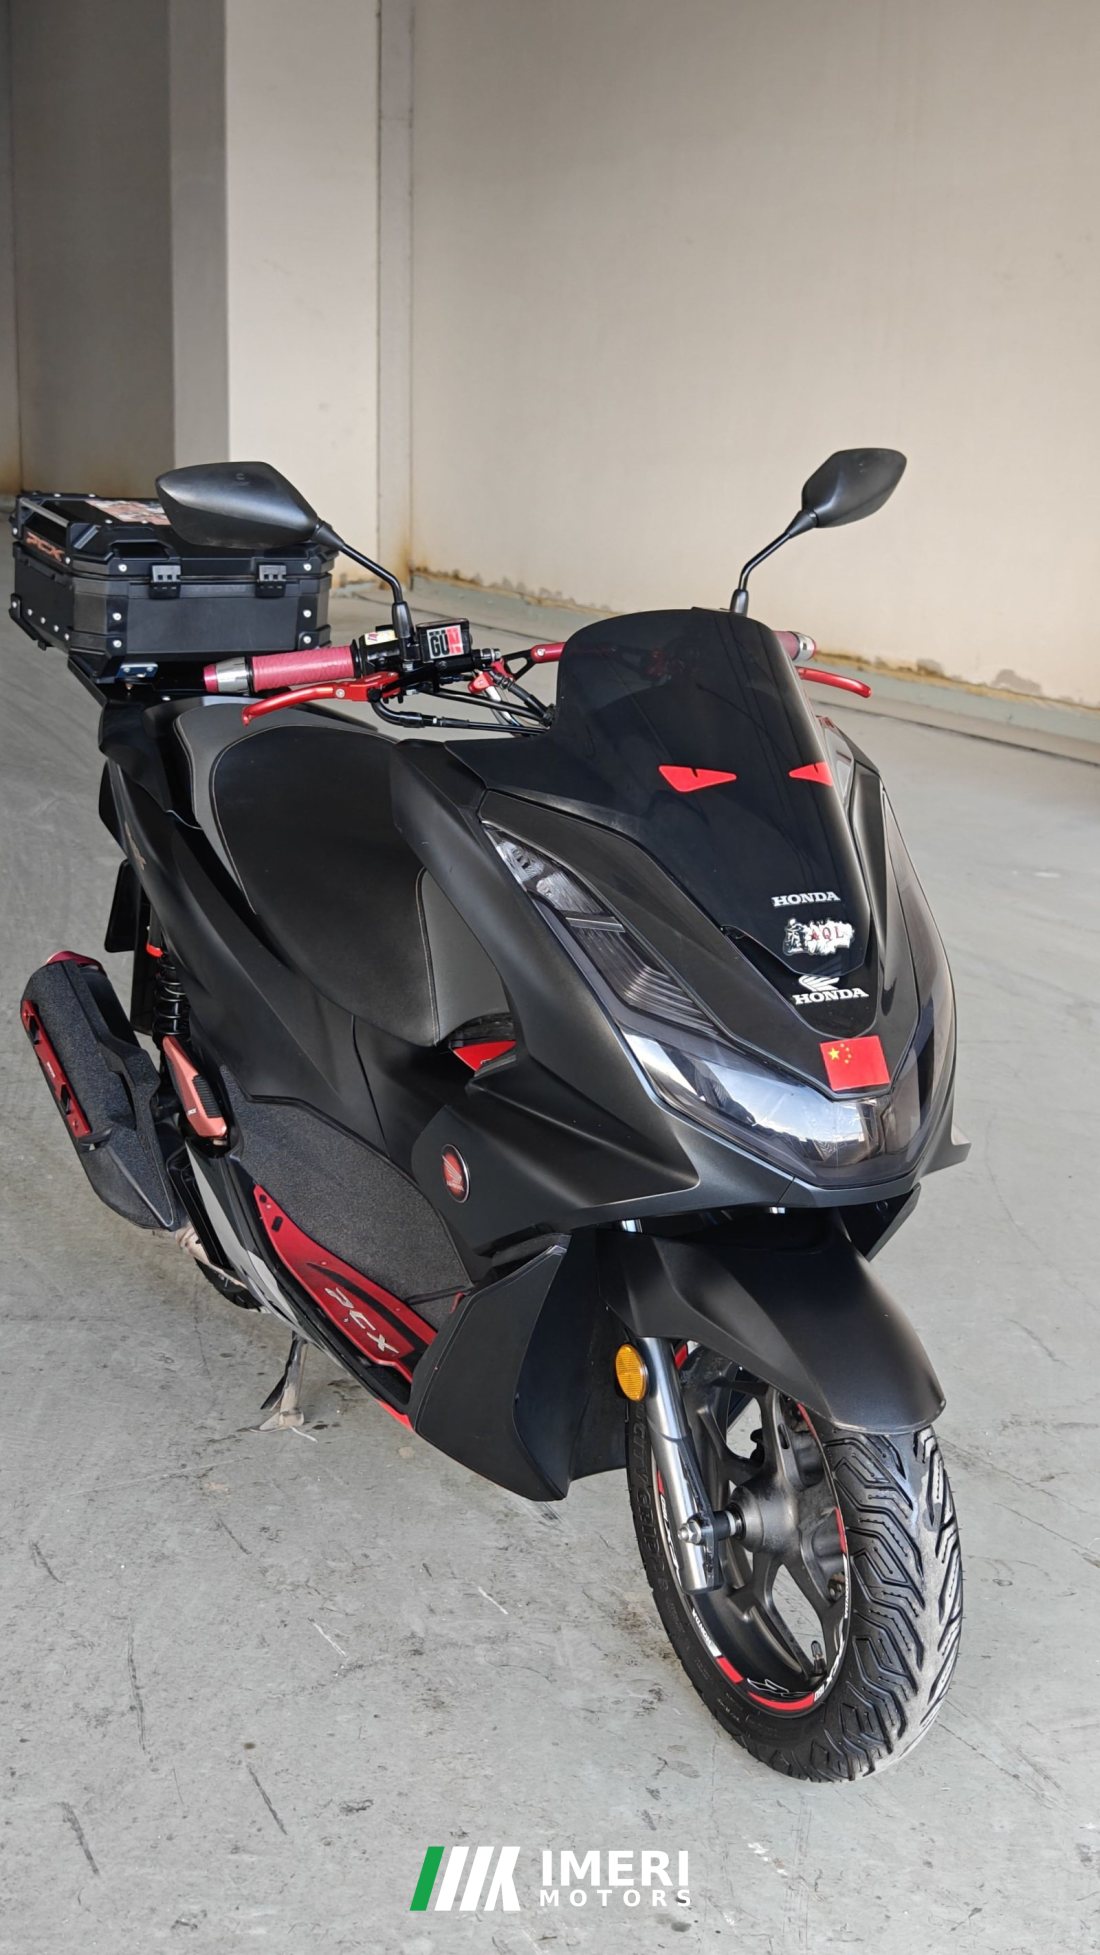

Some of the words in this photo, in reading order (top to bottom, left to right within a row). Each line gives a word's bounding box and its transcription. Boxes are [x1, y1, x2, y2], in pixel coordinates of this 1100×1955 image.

[771, 892, 841, 907] HONDA
[792, 988, 869, 1005] HONDA
[324, 1287, 400, 1354] PCX
